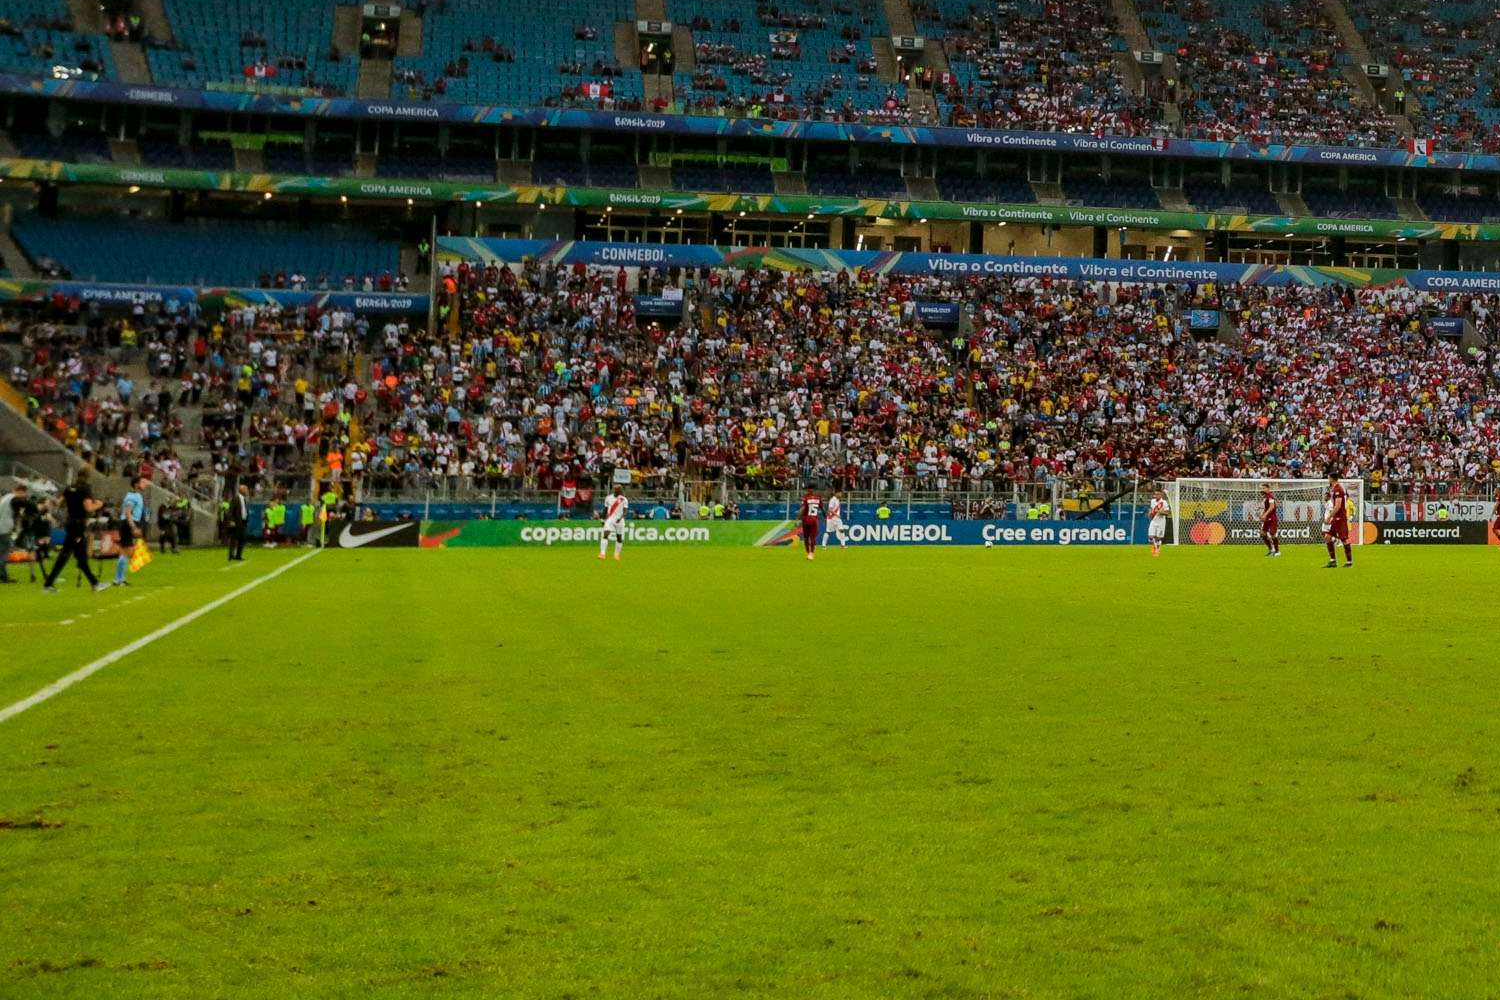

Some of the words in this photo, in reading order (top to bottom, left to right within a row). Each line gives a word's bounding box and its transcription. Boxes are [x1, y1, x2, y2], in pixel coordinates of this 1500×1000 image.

[367, 105, 394, 115] COPA
[395, 107, 439, 117] AMERICA
[646, 119, 666, 129] 2019
[966, 133, 992, 143] Vibra
[1002, 135, 1057, 147] Continente
[1073, 139, 1098, 149] Vibra
[1100, 140, 1108, 149] el
[1320, 151, 1341, 160] COPA
[1342, 152, 1377, 161] AMERICA
[361, 183, 387, 193] COPA
[388, 185, 433, 196] AMERICA
[962, 207, 988, 217] Vibra
[998, 208, 1053, 220] Continente
[1069, 212, 1094, 222] Vibra
[1096, 213, 1104, 222] el
[1105, 213, 1159, 225] Continente
[1317, 223, 1338, 232] COPA
[1339, 224, 1374, 233] AMERICA
[602, 247, 667, 262] CONMEBOL
[928, 258, 968, 271] Vibra
[971, 262, 980, 271] o
[984, 260, 1068, 275] Continente
[1079, 263, 1118, 277] Vibra
[1120, 265, 1133, 278] el
[1137, 266, 1218, 281] Continente
[1427, 276, 1459, 287] COPA
[390, 298, 412, 309] 2019
[982, 524, 1027, 541] Cree
[1031, 528, 1055, 541] en
[1231, 527, 1311, 538] masrcard
[1383, 526, 1461, 538] mastercard
